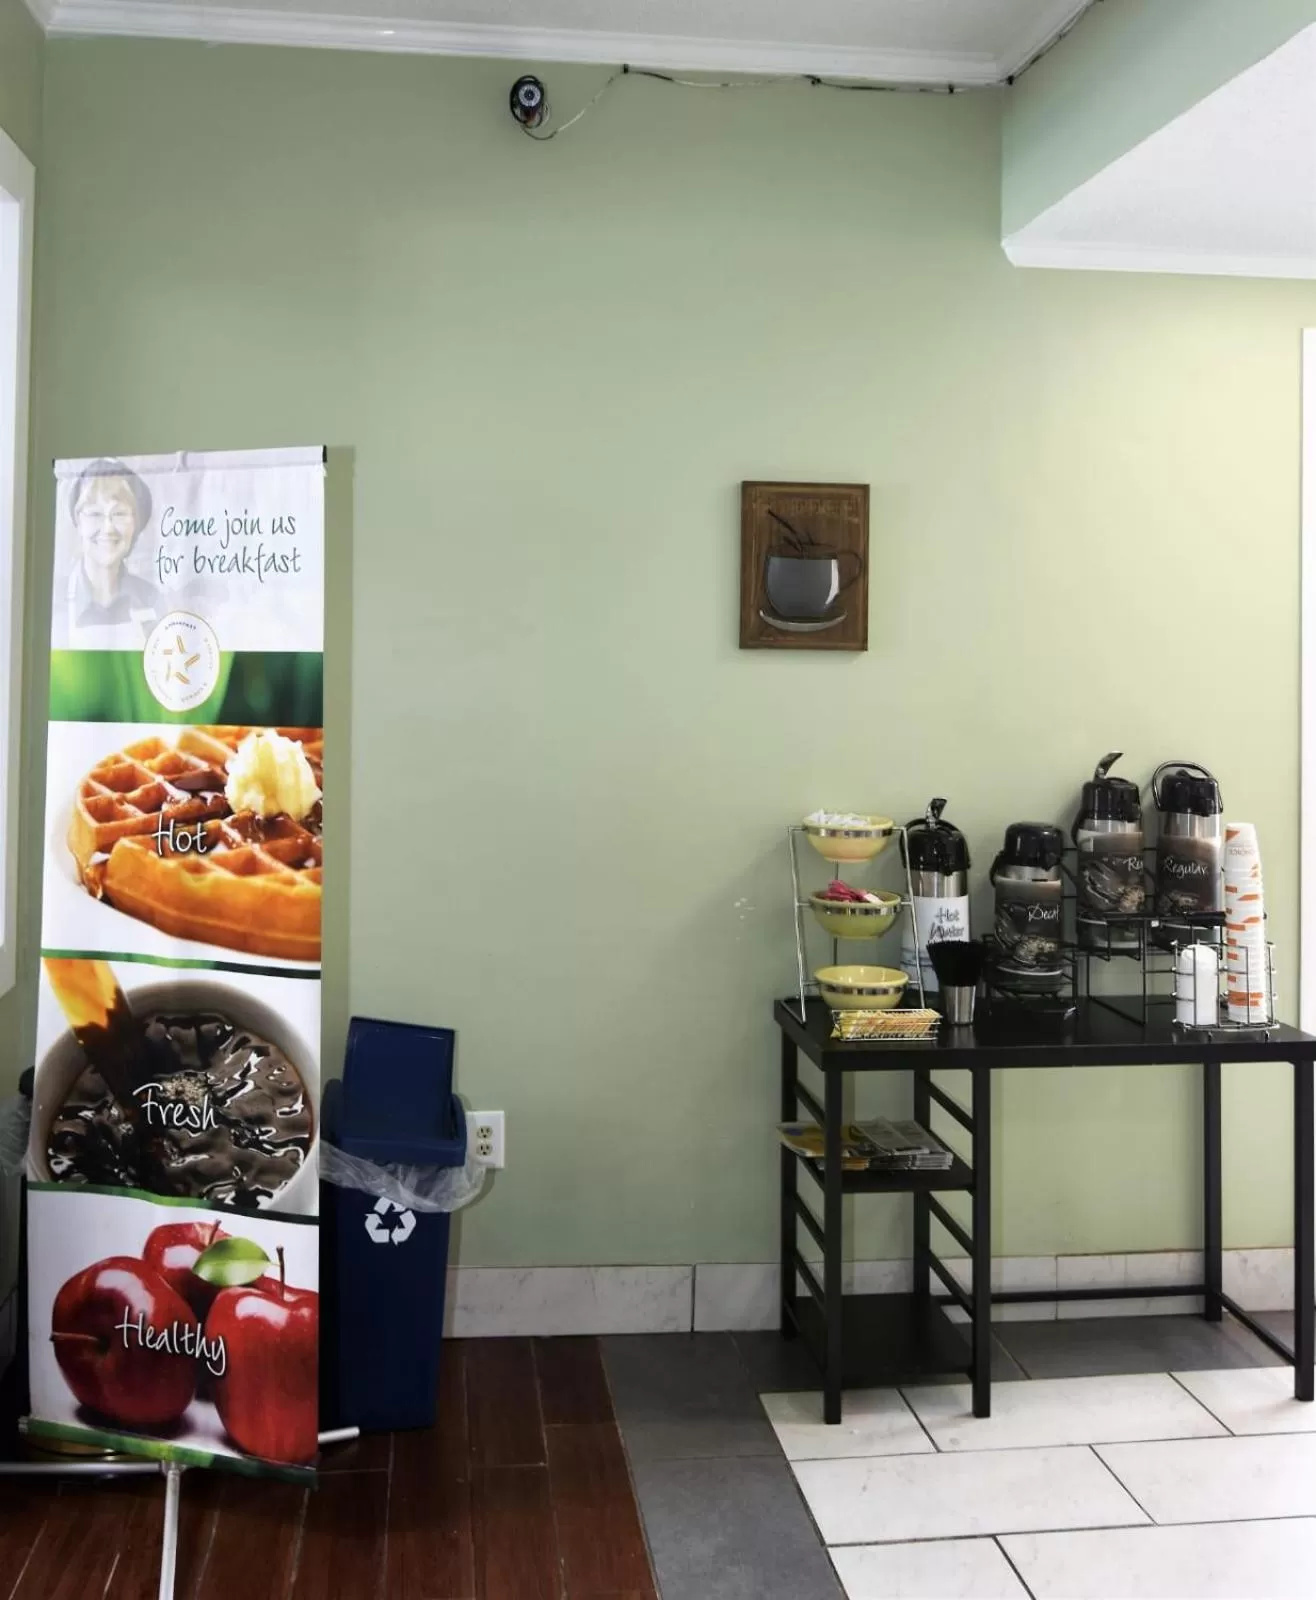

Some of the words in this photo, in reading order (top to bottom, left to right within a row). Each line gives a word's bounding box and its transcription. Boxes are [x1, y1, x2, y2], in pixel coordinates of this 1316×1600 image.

[160, 506, 217, 537] Come
[221, 509, 263, 549] join
[271, 514, 296, 536] us
[156, 545, 184, 584] for
[193, 543, 301, 583] breakfast
[152, 811, 207, 856] Hot
[1165, 856, 1208, 878] Regular
[934, 907, 960, 924] Hot
[132, 1082, 218, 1130] Fresh
[114, 1305, 226, 1376] Healthy
